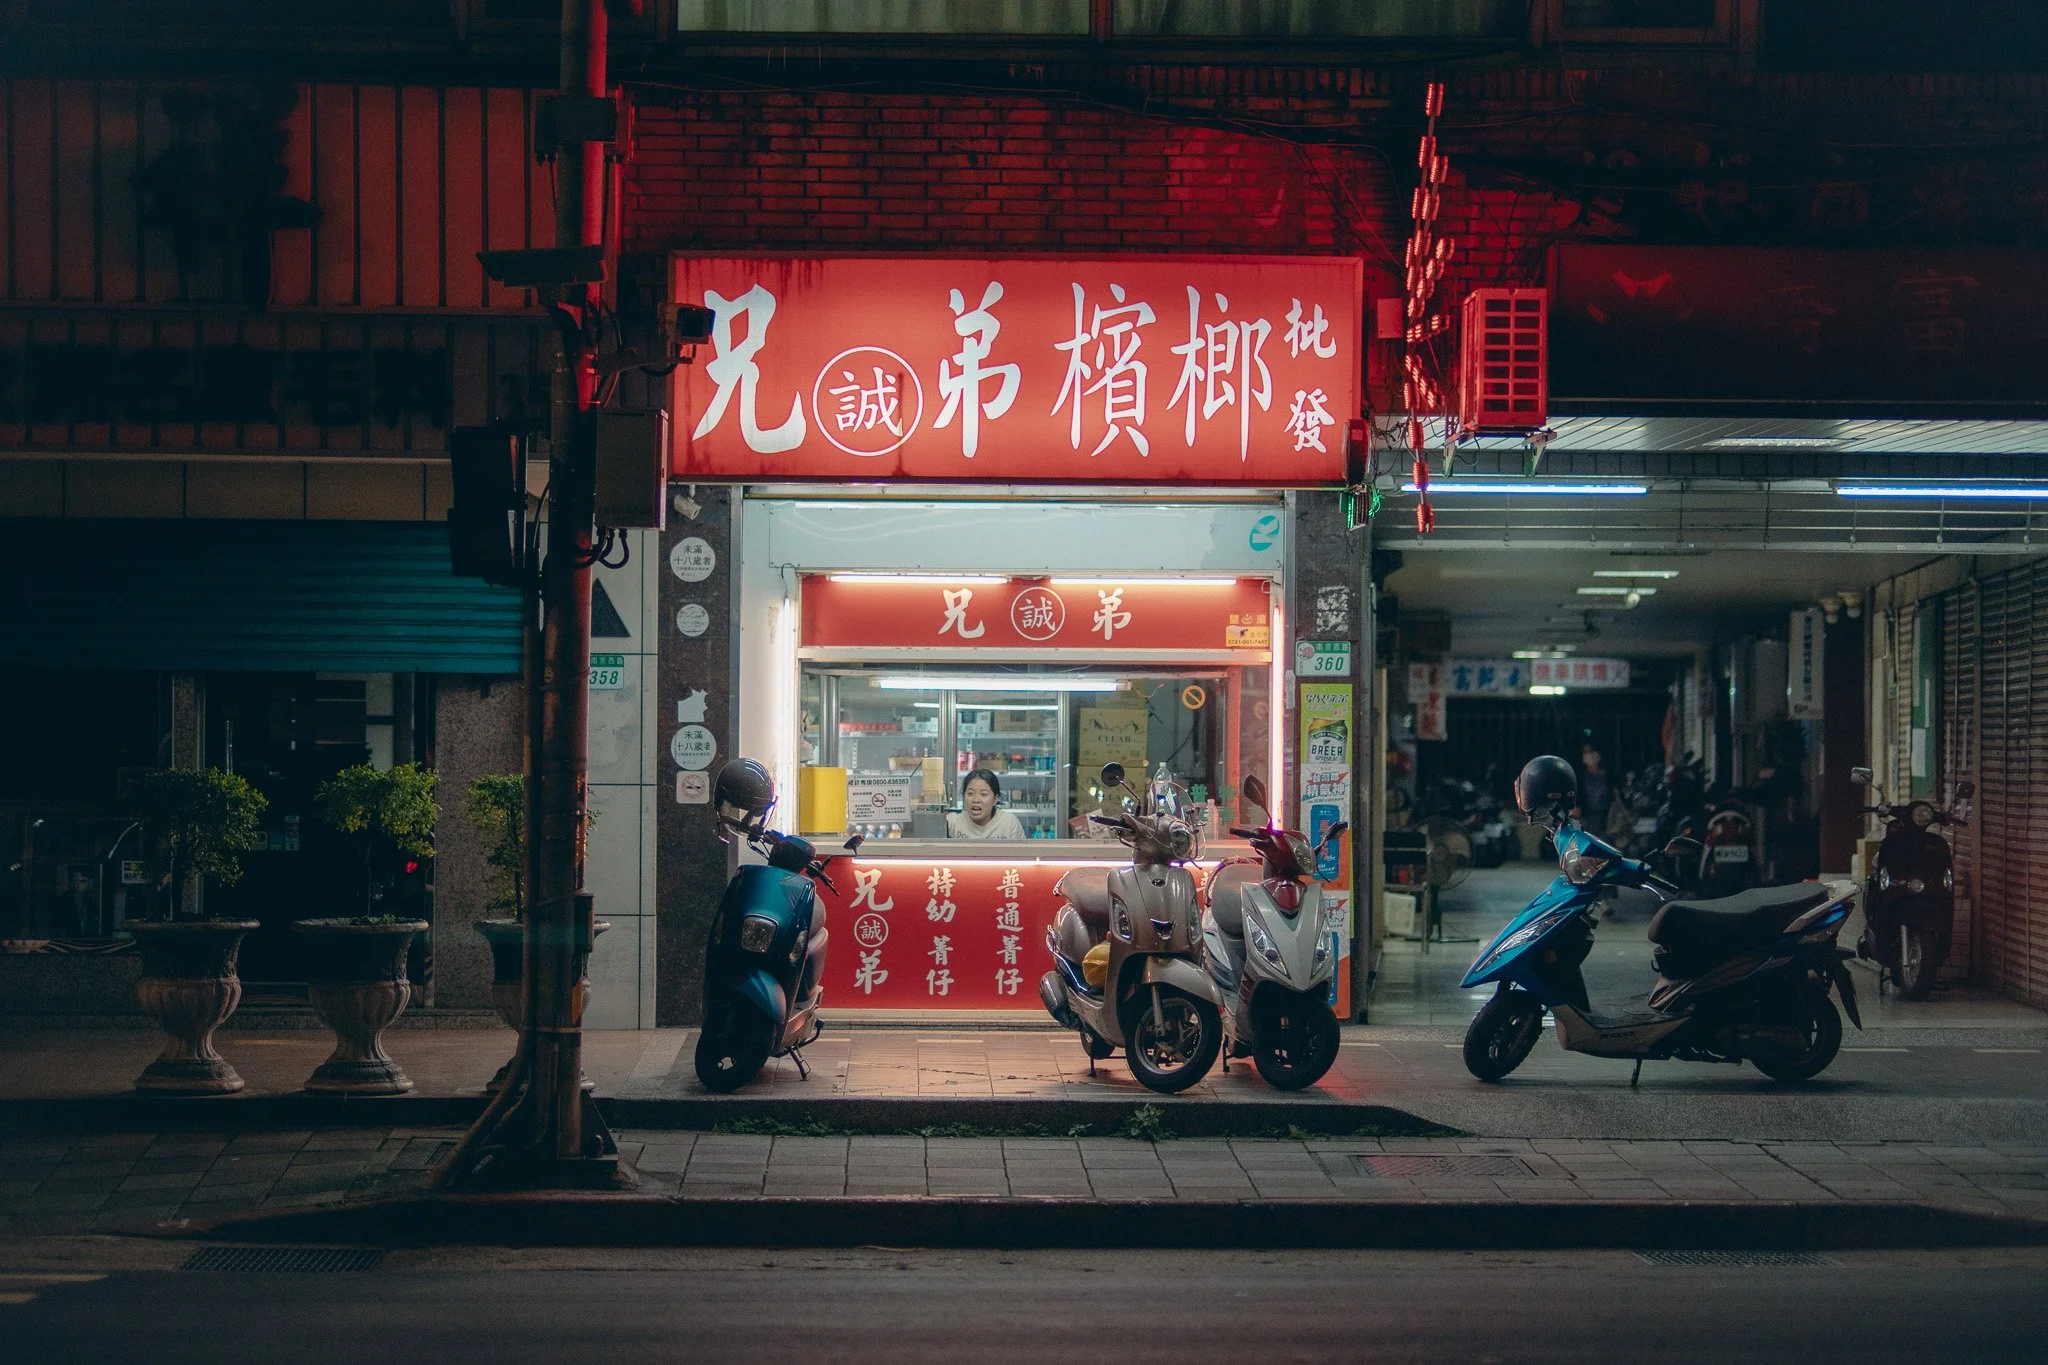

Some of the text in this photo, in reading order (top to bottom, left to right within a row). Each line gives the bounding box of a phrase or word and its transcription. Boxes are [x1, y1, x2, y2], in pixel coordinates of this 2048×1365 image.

[1284, 298, 1336, 454] 批發
[683, 544, 703, 554] 未滿
[1314, 656, 1344, 671] 360
[589, 670, 619, 685] 358
[684, 730, 703, 740] 未滿
[1097, 735, 1132, 743] CLEAR
[1311, 744, 1343, 757] BREER
[926, 868, 957, 996] 特幼菁仔
[995, 868, 1025, 996] 普通菁仔
